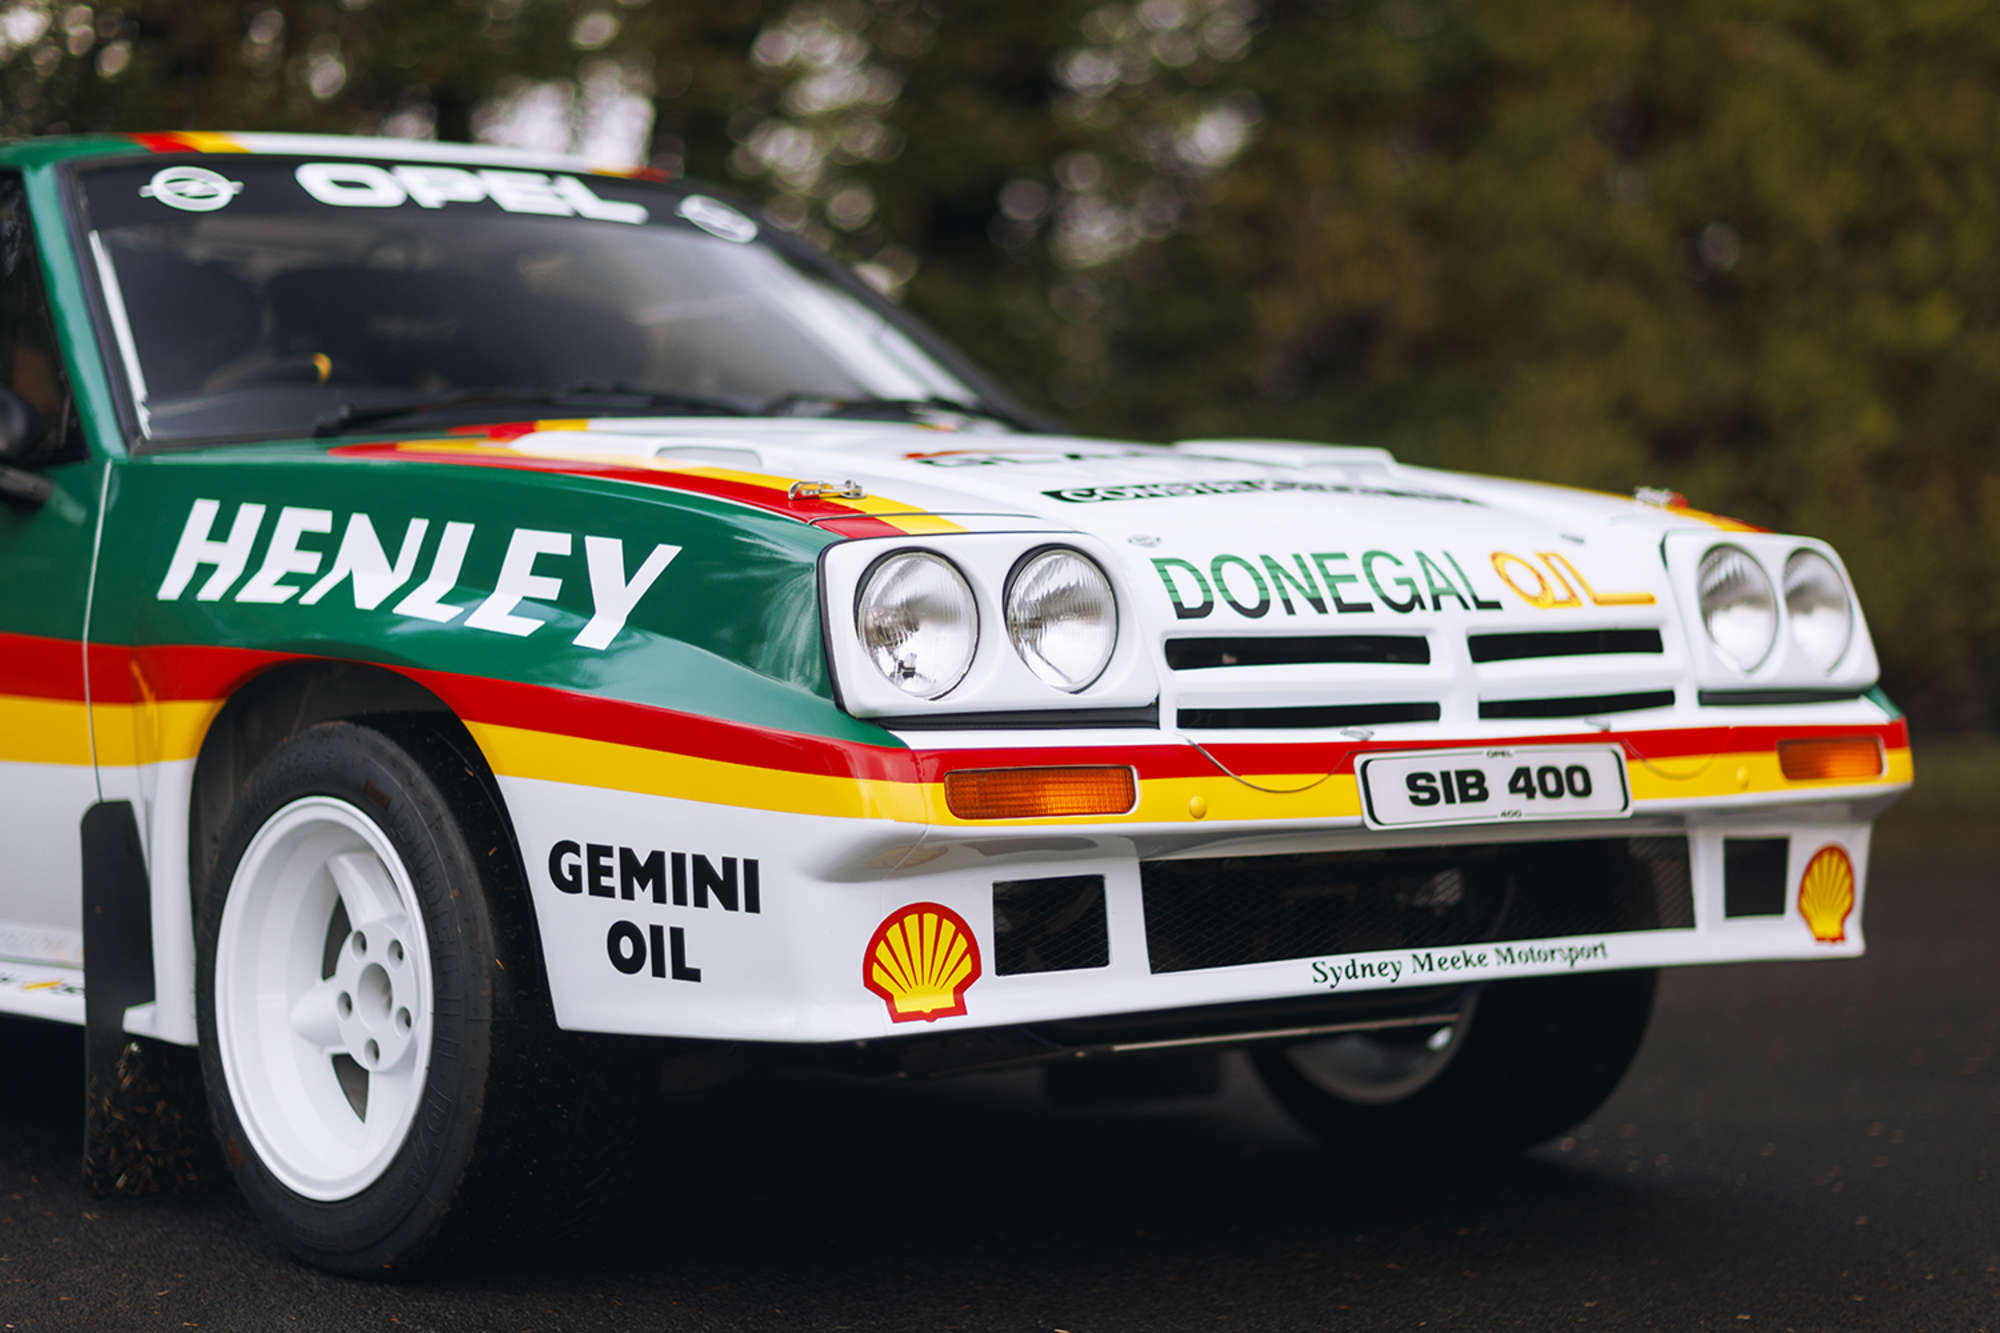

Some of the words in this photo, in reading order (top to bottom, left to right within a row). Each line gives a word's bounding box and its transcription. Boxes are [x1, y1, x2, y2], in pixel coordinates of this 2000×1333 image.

[295, 162, 649, 225] OPEL
[157, 498, 683, 650] HENLEY
[1150, 550, 1503, 620] DONEGAL
[1490, 551, 1657, 610] OIL
[1405, 768, 1490, 807] SIB
[1507, 764, 1593, 800] 400
[548, 839, 761, 914] GEMINI
[606, 920, 702, 983] OIL
[1311, 957, 1402, 989] Sydney
[1411, 950, 1489, 974] Meeke
[1496, 940, 1609, 969] Motorsport
